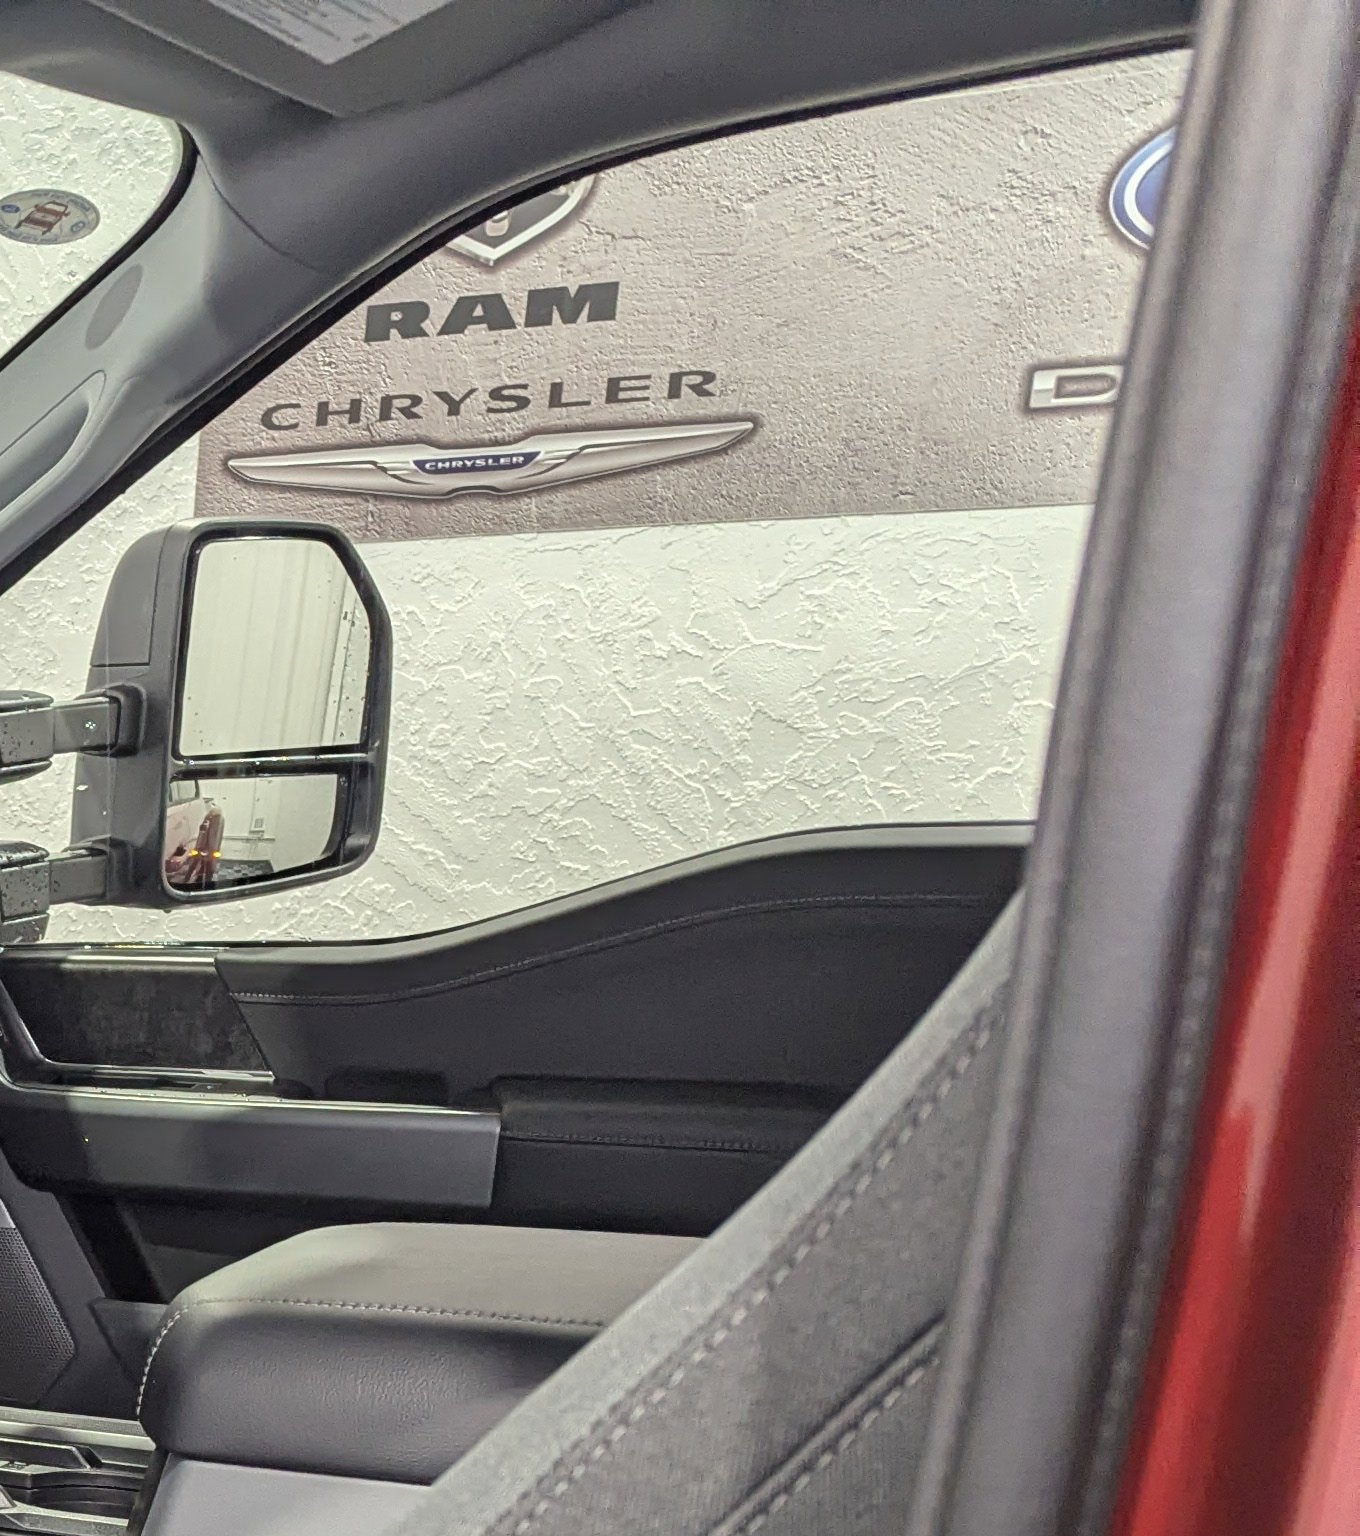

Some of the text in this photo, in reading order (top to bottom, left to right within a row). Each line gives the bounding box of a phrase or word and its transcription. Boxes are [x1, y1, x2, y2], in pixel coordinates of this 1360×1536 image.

[363, 280, 620, 343] RAM
[260, 369, 723, 432] CHRYSLER
[423, 451, 527, 473] CHRYSLER
